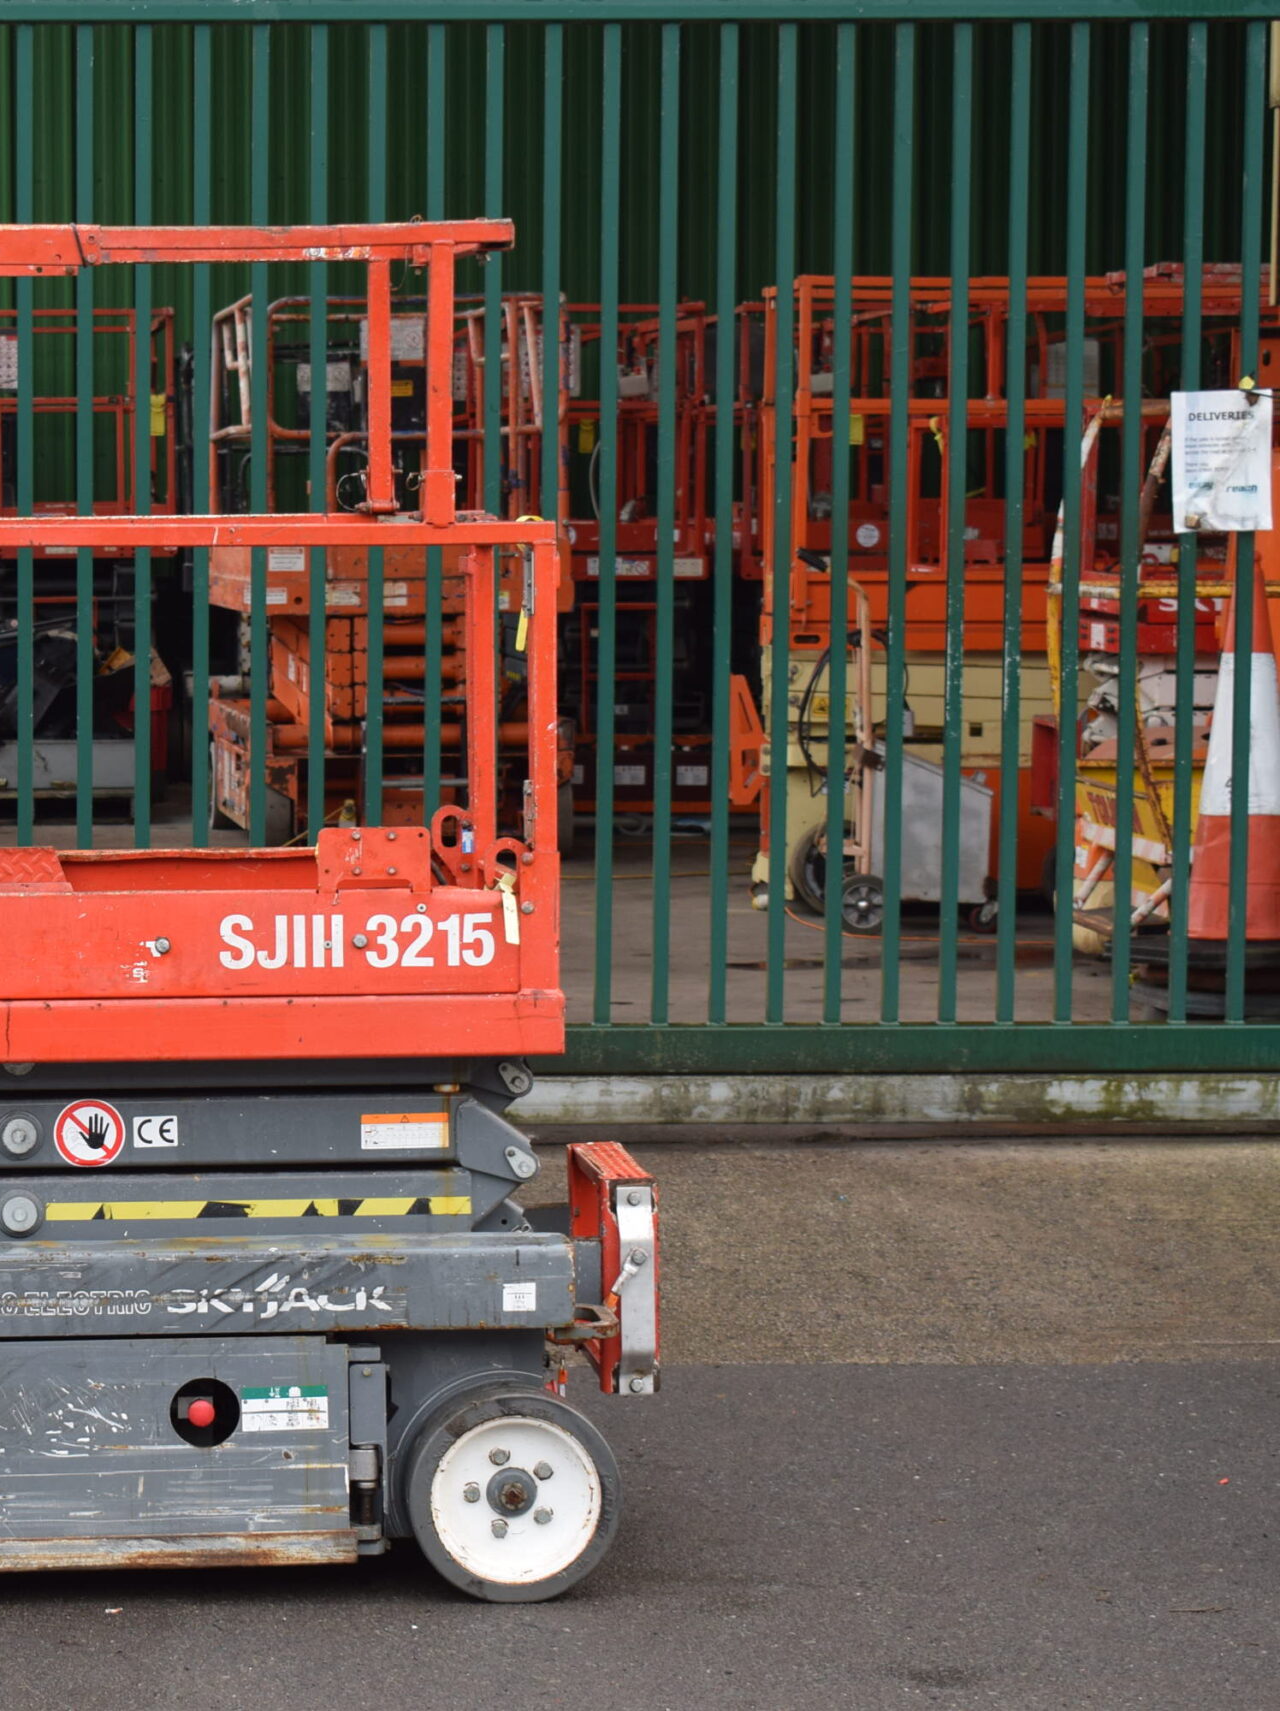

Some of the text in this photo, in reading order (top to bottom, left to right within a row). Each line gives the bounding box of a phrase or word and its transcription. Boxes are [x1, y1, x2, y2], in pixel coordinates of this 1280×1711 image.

[1188, 411, 1254, 421] DELIVERIES
[219, 912, 496, 970] SJIII 3215
[137, 1118, 175, 1144] CE
[167, 1272, 393, 1319] SKYJACK
